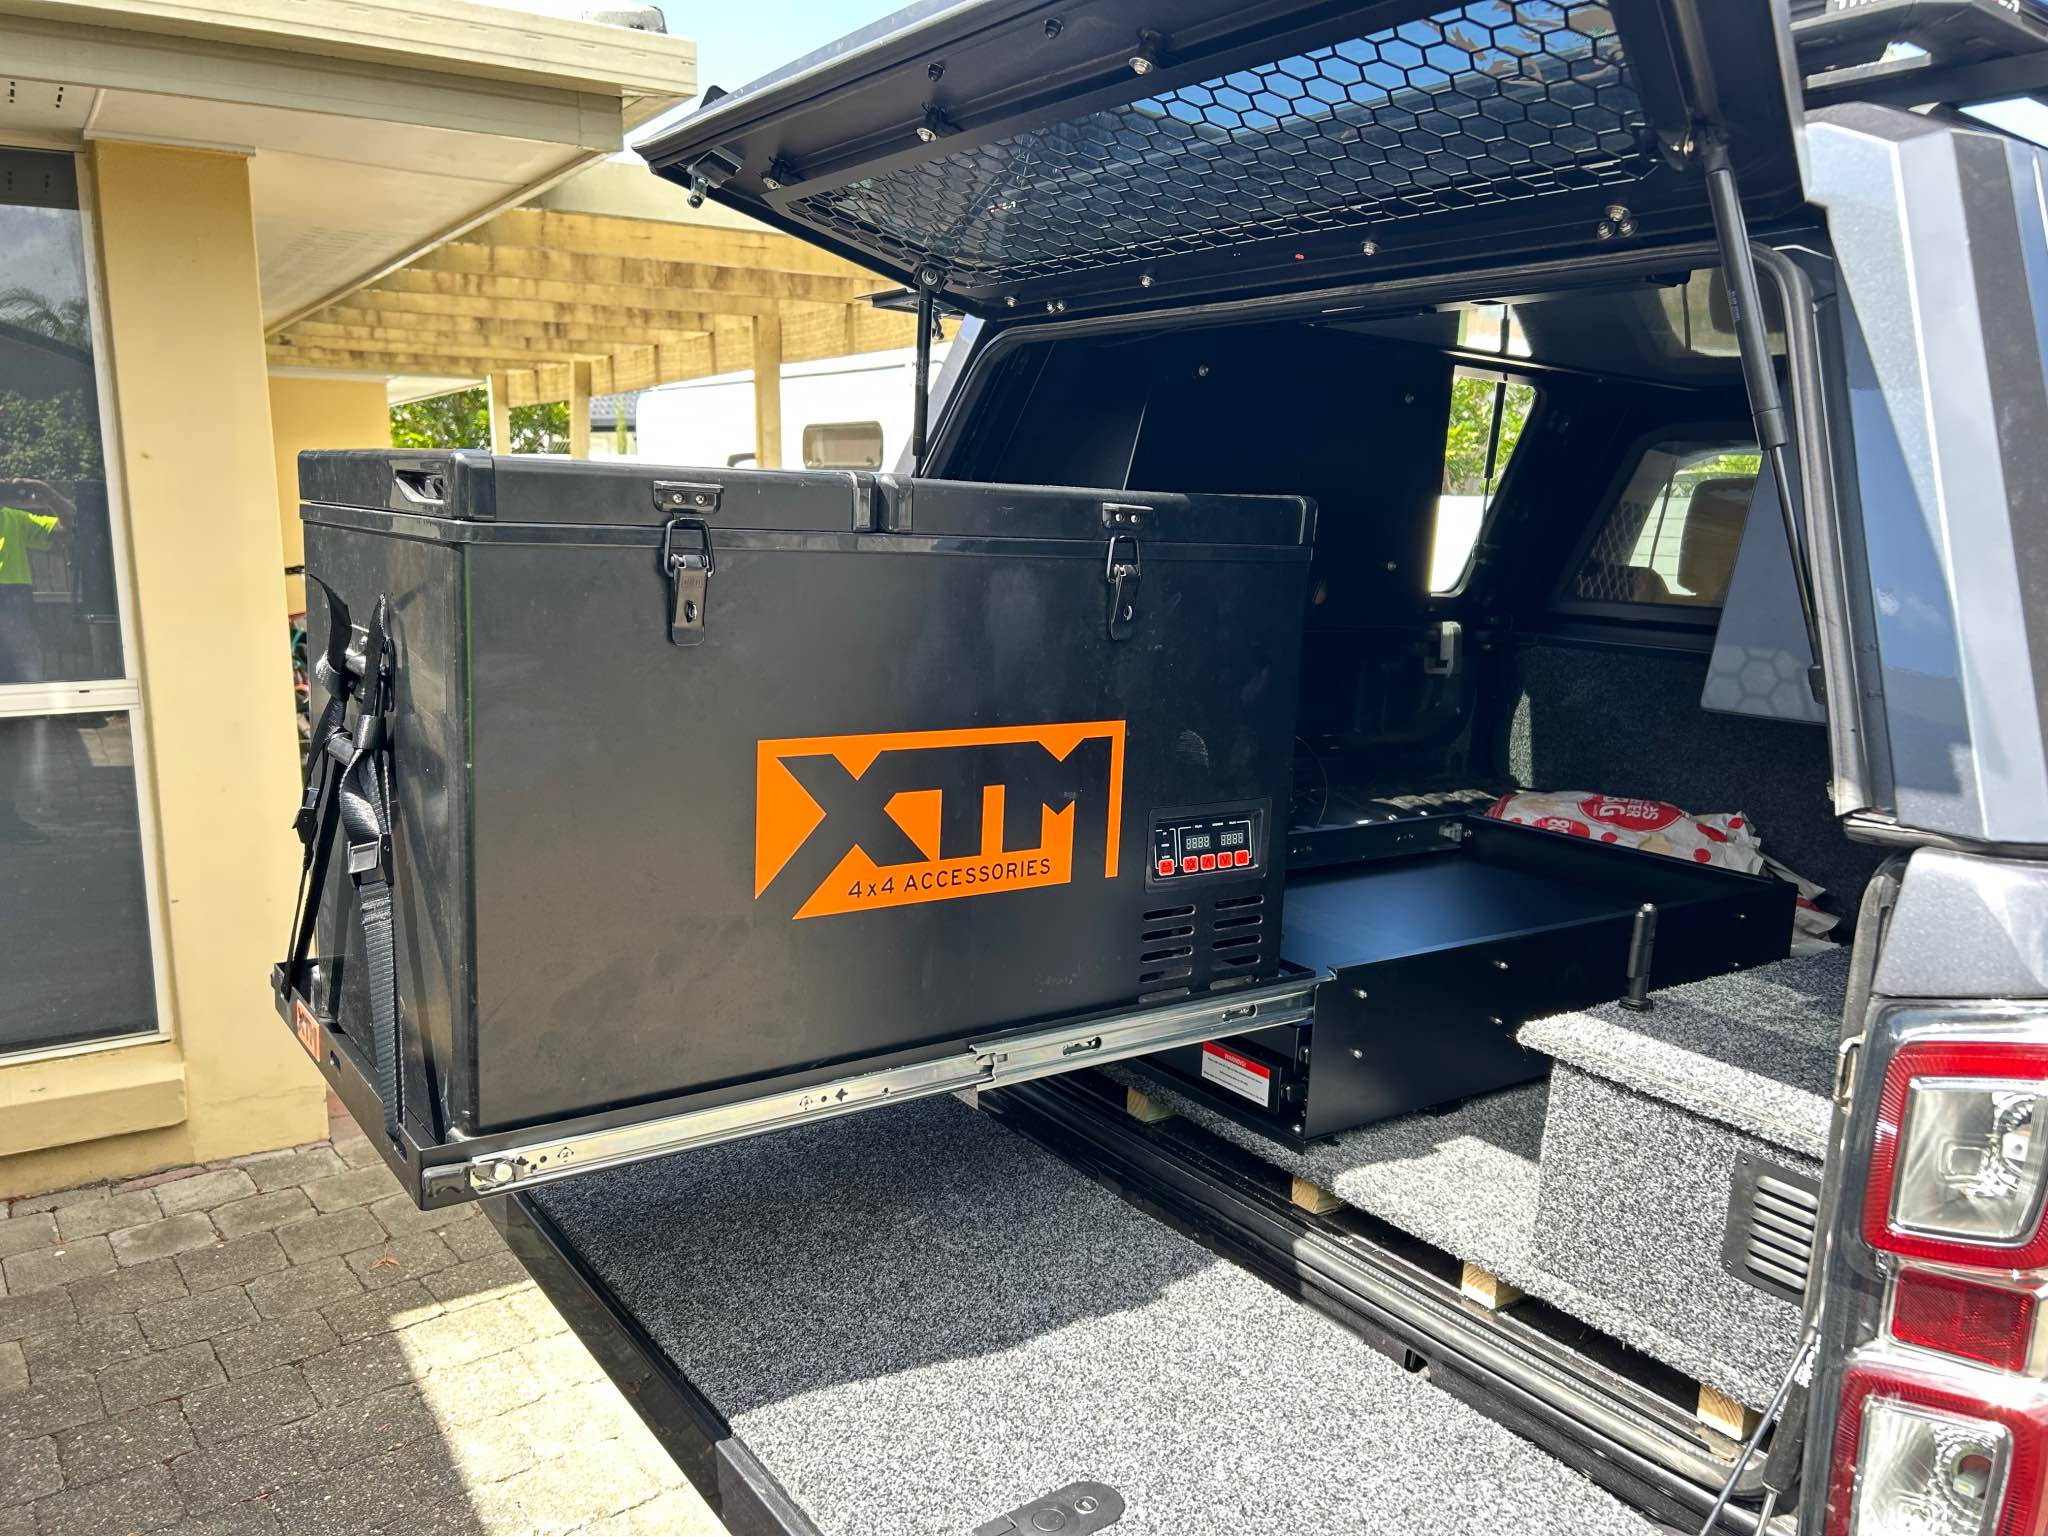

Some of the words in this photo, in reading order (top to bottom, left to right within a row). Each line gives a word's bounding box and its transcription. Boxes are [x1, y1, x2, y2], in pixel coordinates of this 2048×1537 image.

[756, 736, 1114, 918] XTM
[847, 877, 895, 898] 4x4
[903, 857, 1052, 893] ACCESSORIES
